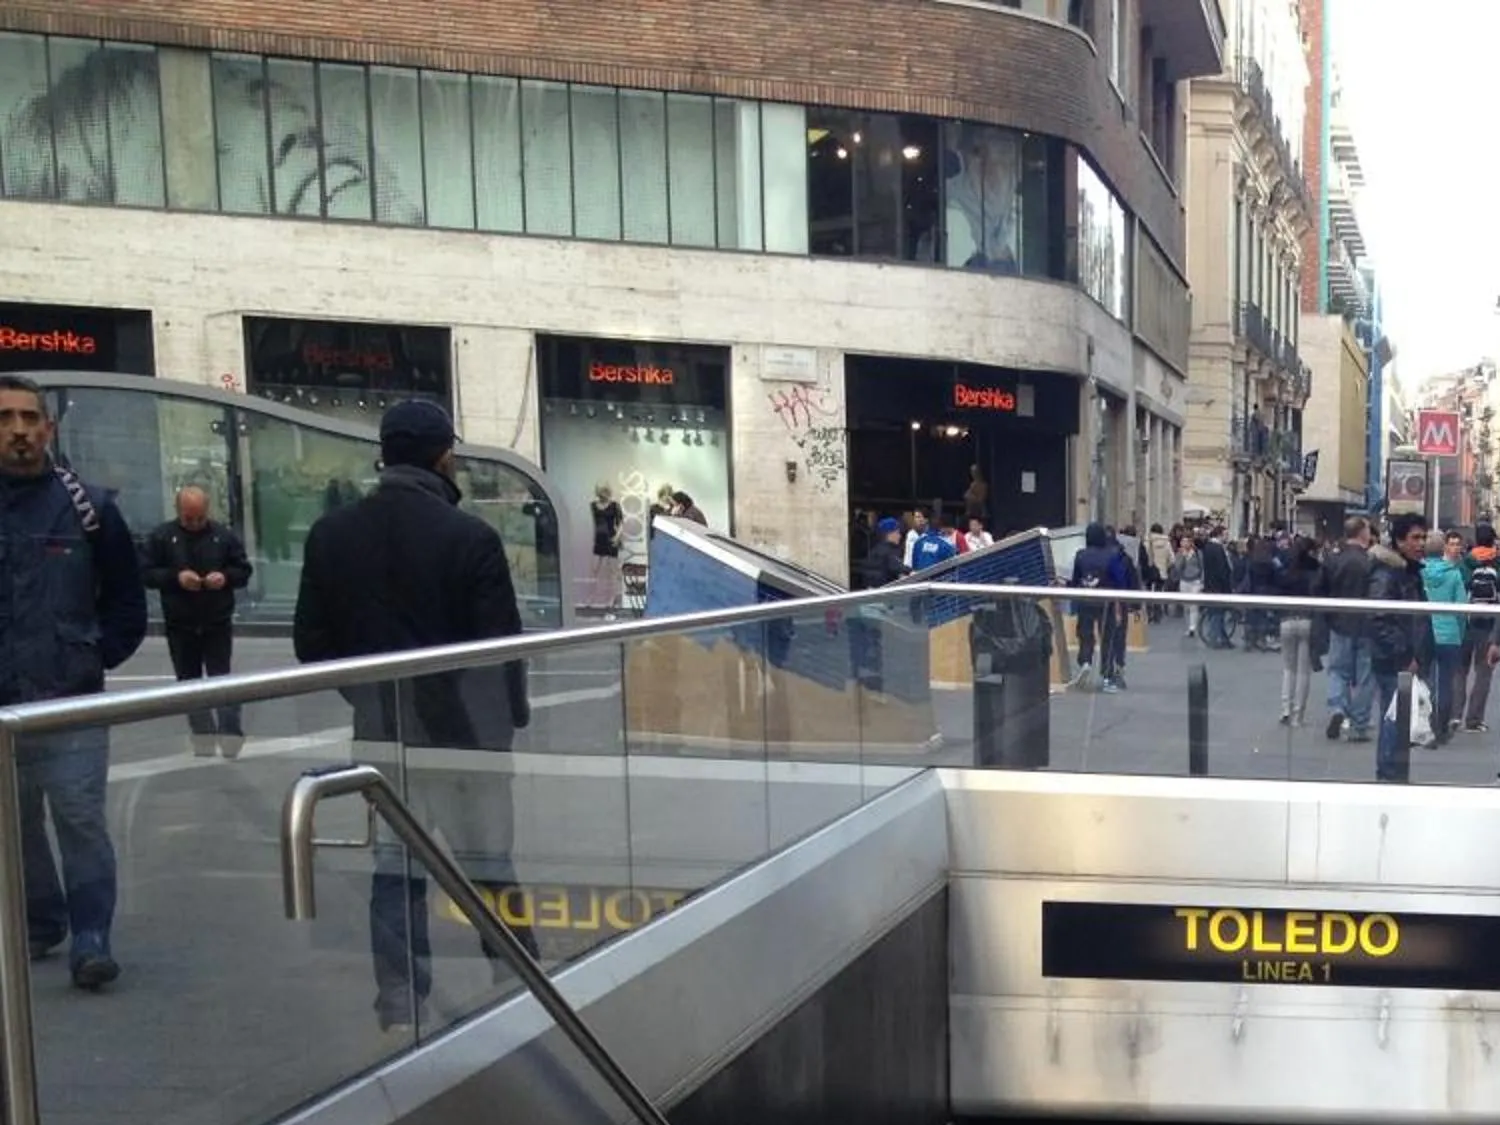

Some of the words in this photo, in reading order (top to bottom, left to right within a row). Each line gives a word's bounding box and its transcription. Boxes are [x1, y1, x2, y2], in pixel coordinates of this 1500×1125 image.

[0, 326, 97, 354] Bershka
[589, 361, 674, 385] Bershka
[954, 383, 1015, 411] Bershka
[1174, 907, 1400, 957] TOLEDO
[1242, 960, 1313, 981] LINEA
[1321, 961, 1333, 982] 1
